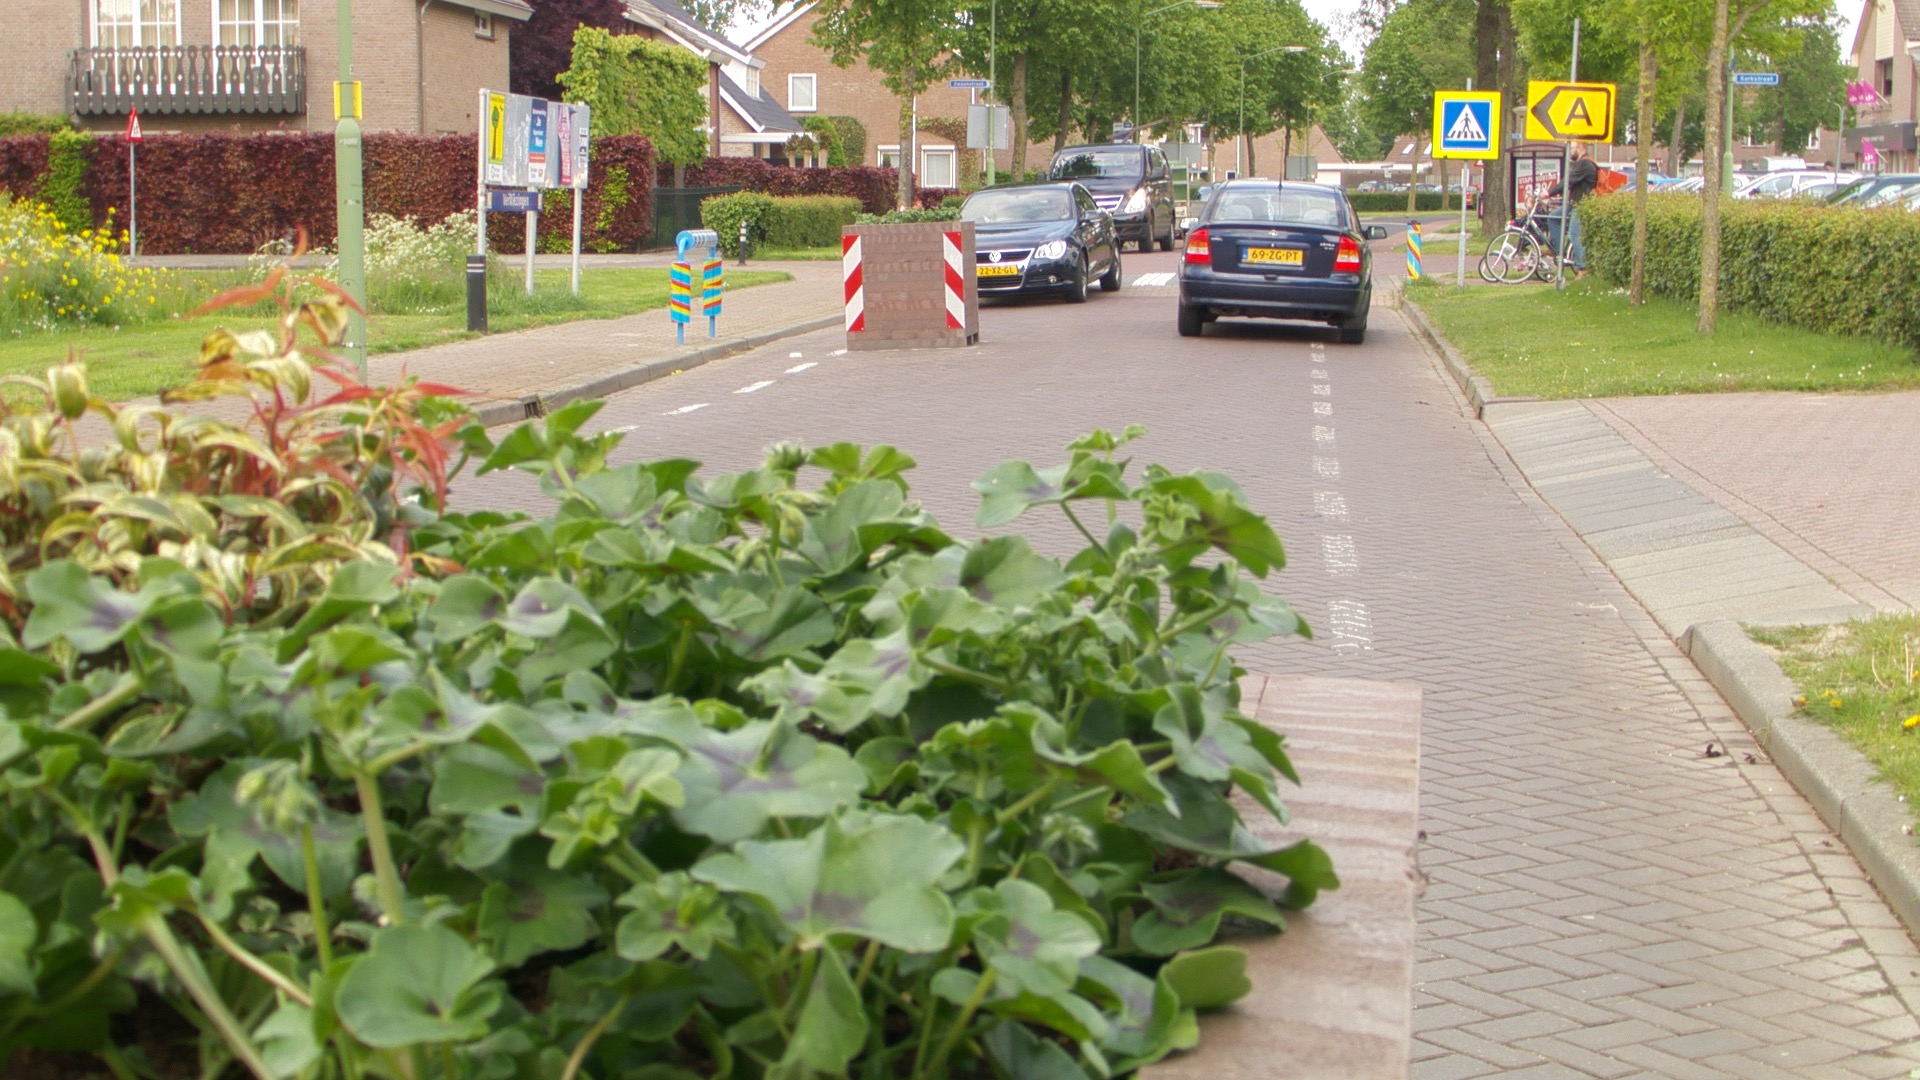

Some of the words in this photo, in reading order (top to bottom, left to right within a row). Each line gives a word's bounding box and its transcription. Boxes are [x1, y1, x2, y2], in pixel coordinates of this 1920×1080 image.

[1740, 75, 1774, 83] Kerkstraat
[1564, 96, 1593, 127] A
[1251, 250, 1299, 261] 69-ZG-PT
[979, 266, 1015, 276] 22-XZ-GL
